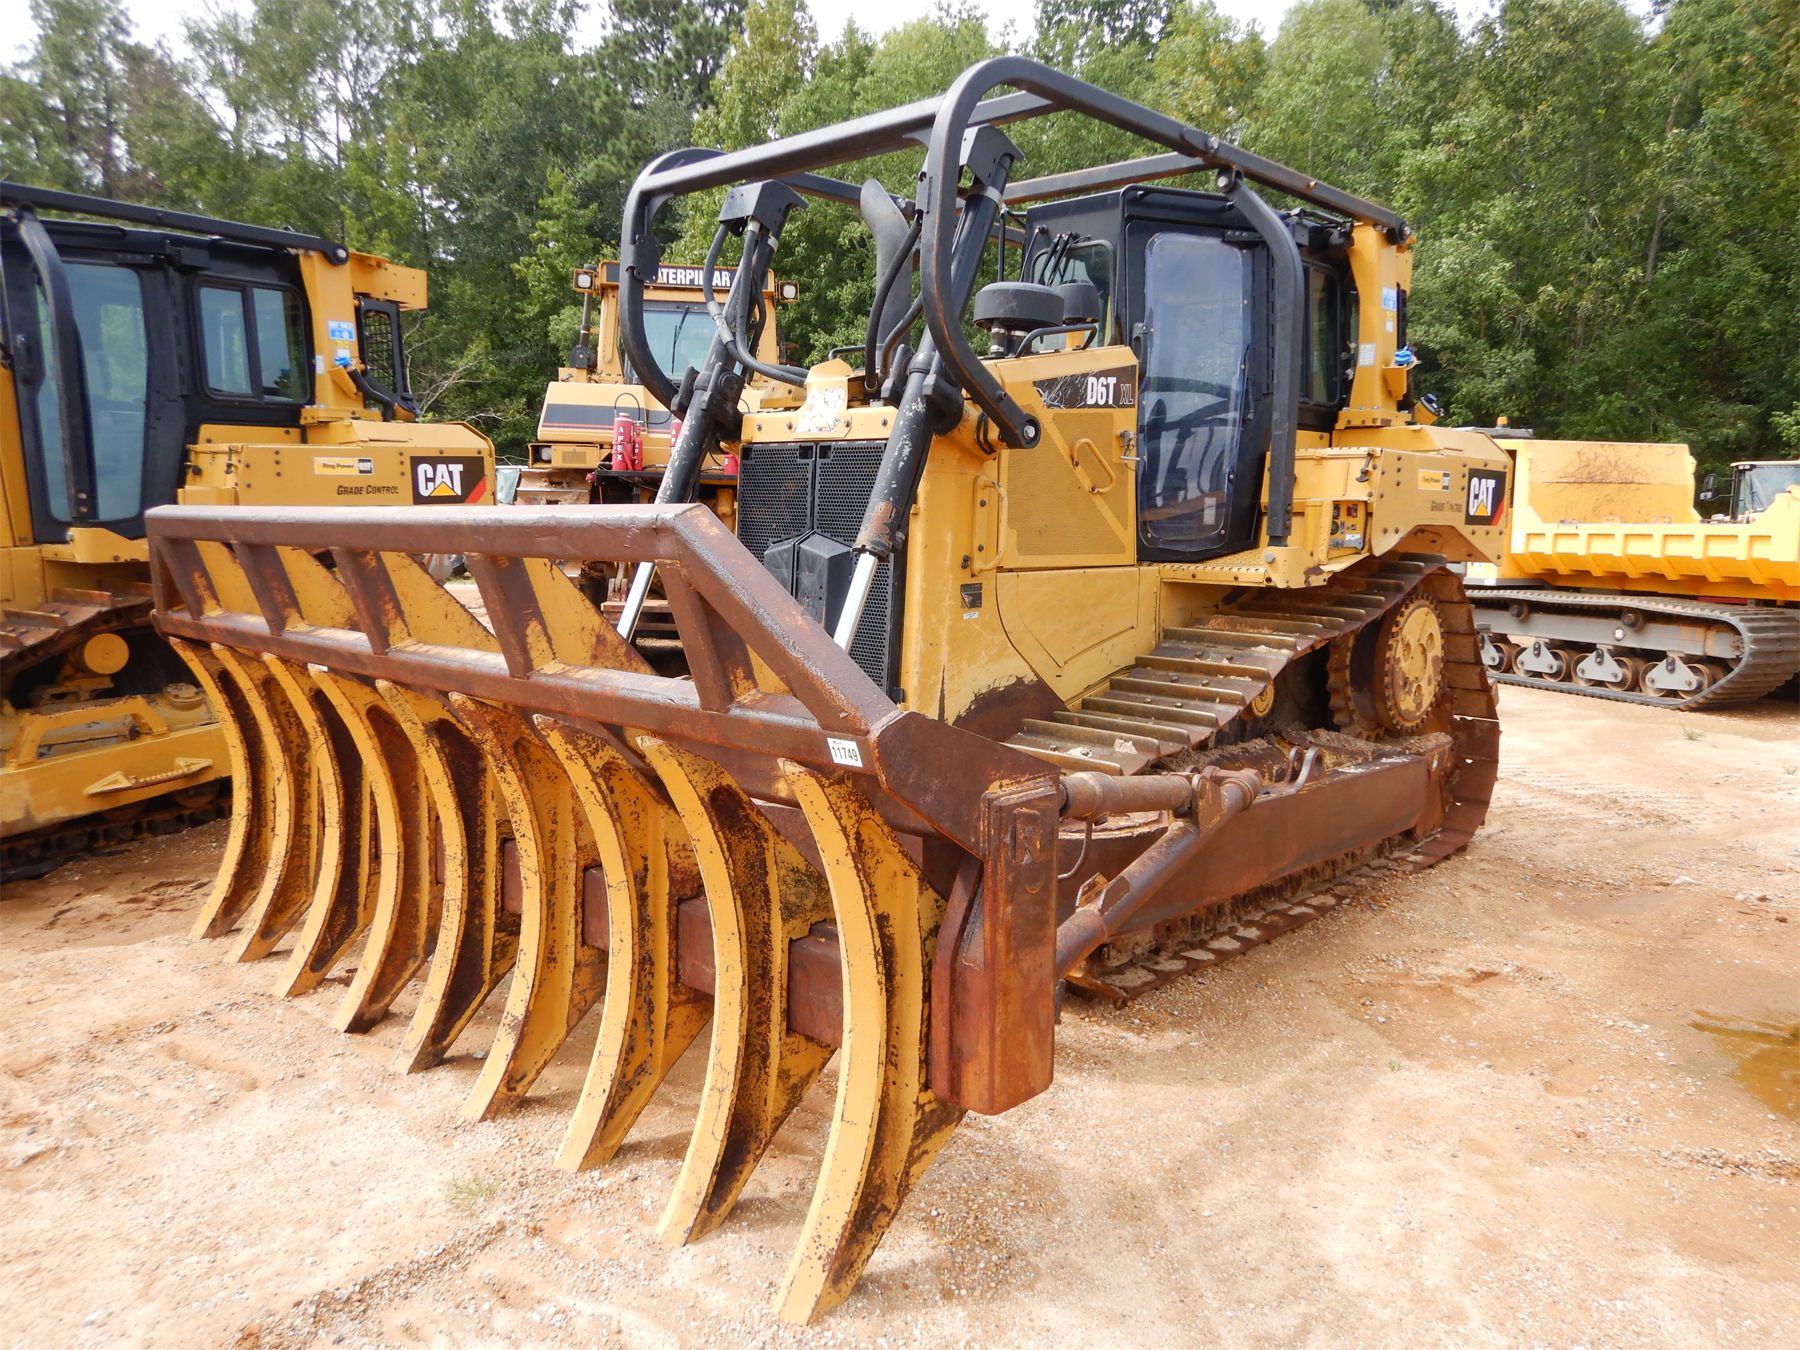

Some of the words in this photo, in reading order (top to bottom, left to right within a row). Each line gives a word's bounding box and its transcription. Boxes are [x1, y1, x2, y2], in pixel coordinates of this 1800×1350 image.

[1086, 376, 1117, 405] D6T
[1119, 383, 1134, 405] XL
[417, 463, 464, 497] CAT
[1468, 477, 1496, 516] CAT
[832, 745, 859, 762] 11749
